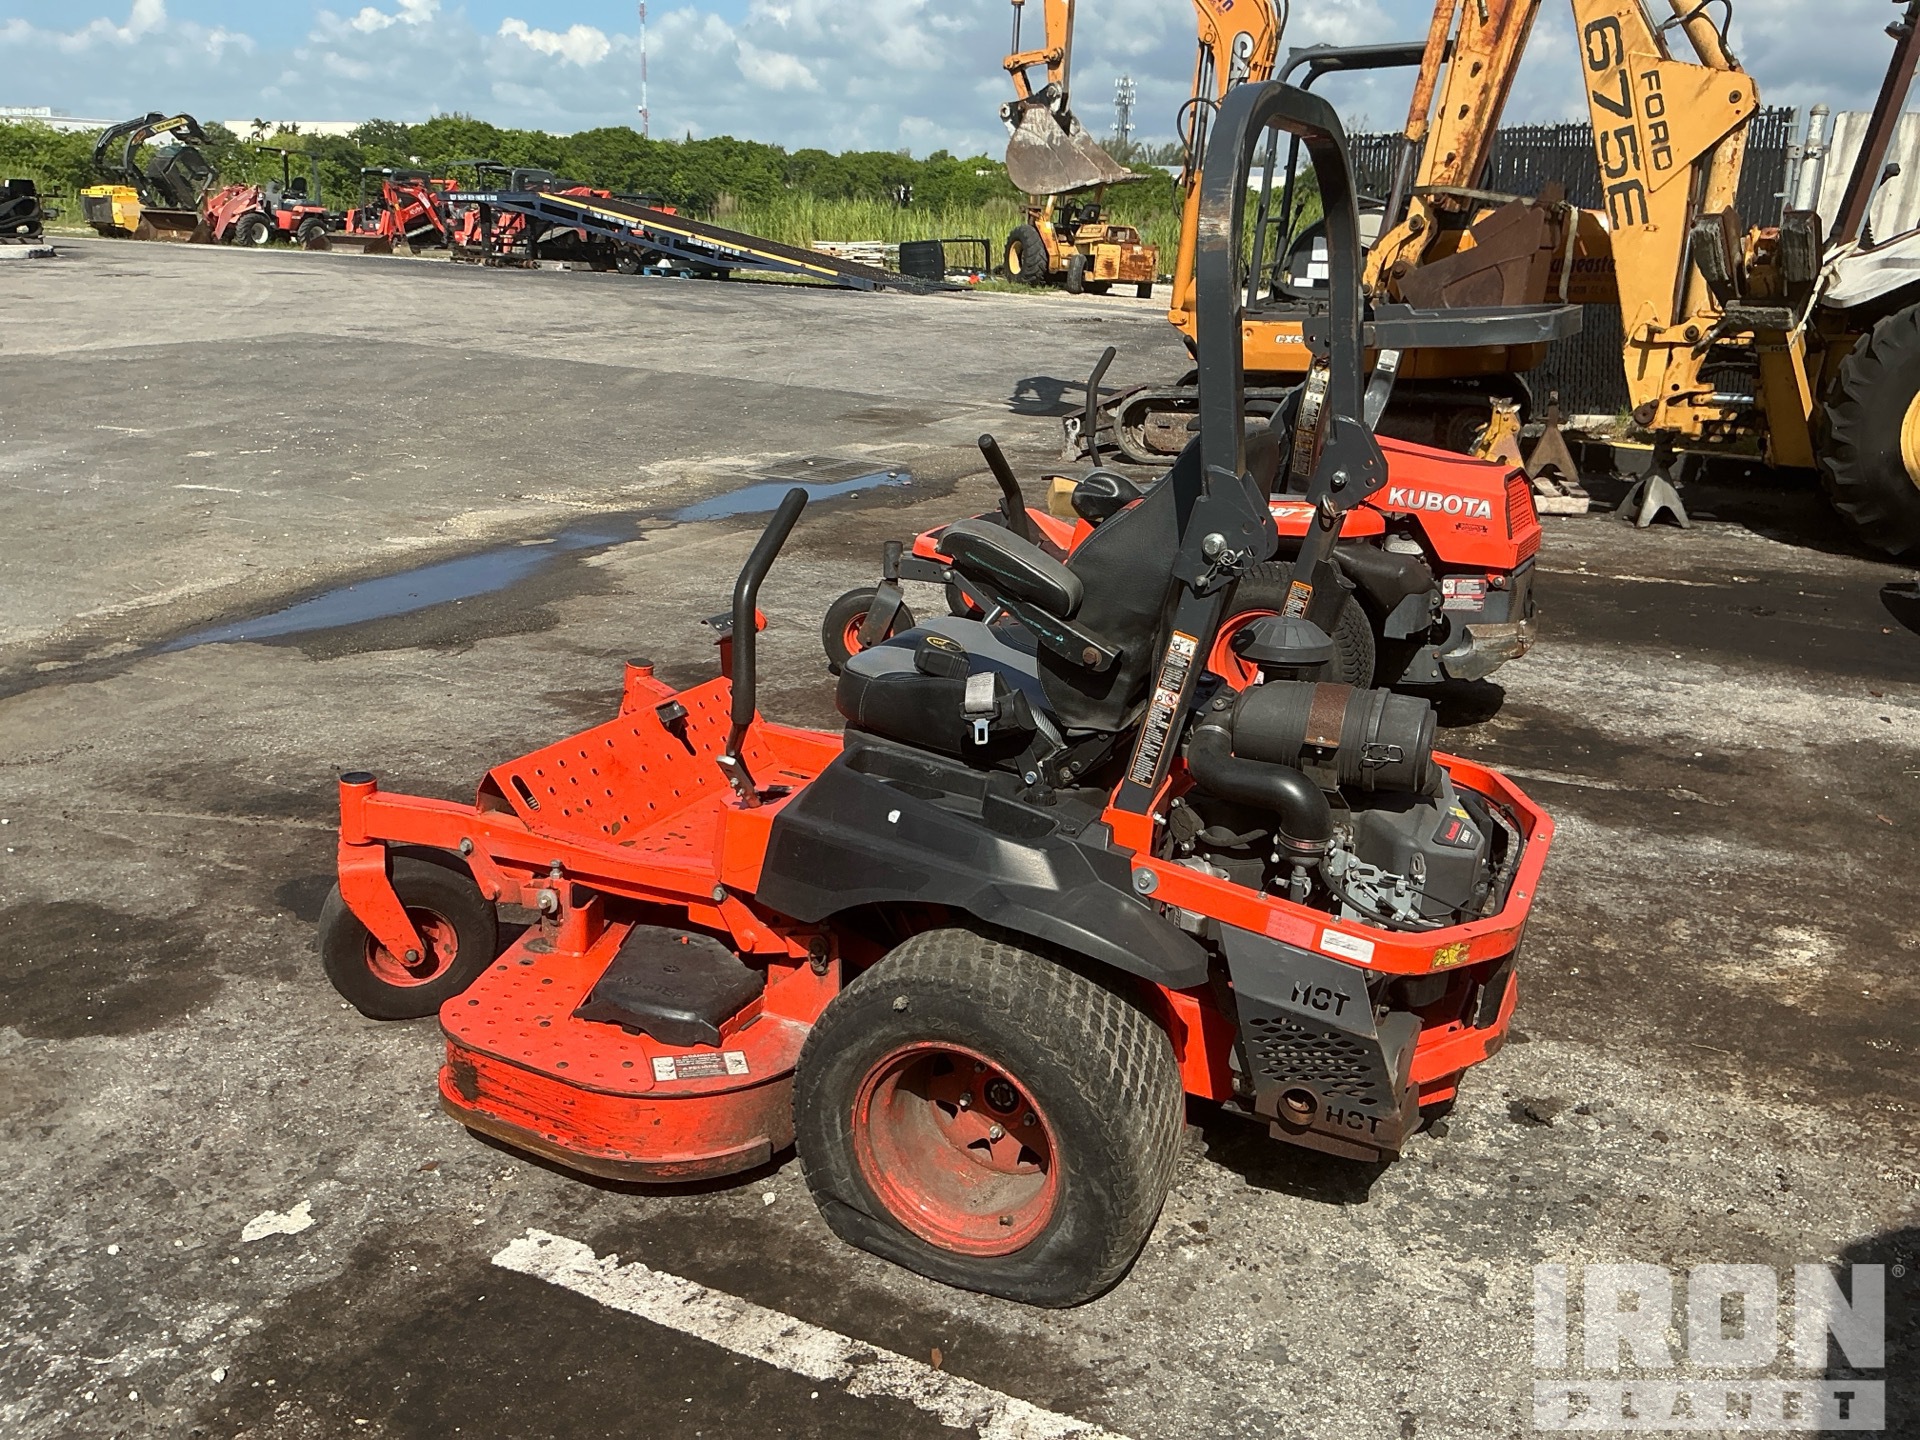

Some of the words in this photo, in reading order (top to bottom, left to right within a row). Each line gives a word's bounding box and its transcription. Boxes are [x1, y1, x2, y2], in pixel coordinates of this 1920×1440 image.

[1585, 16, 1649, 230] 675E
[1641, 70, 1673, 171] FORD
[1275, 334, 1304, 344] CX5
[1388, 487, 1492, 520] KUBOTA
[1291, 981, 1350, 1016] HOT
[1326, 1105, 1383, 1134] HOT
